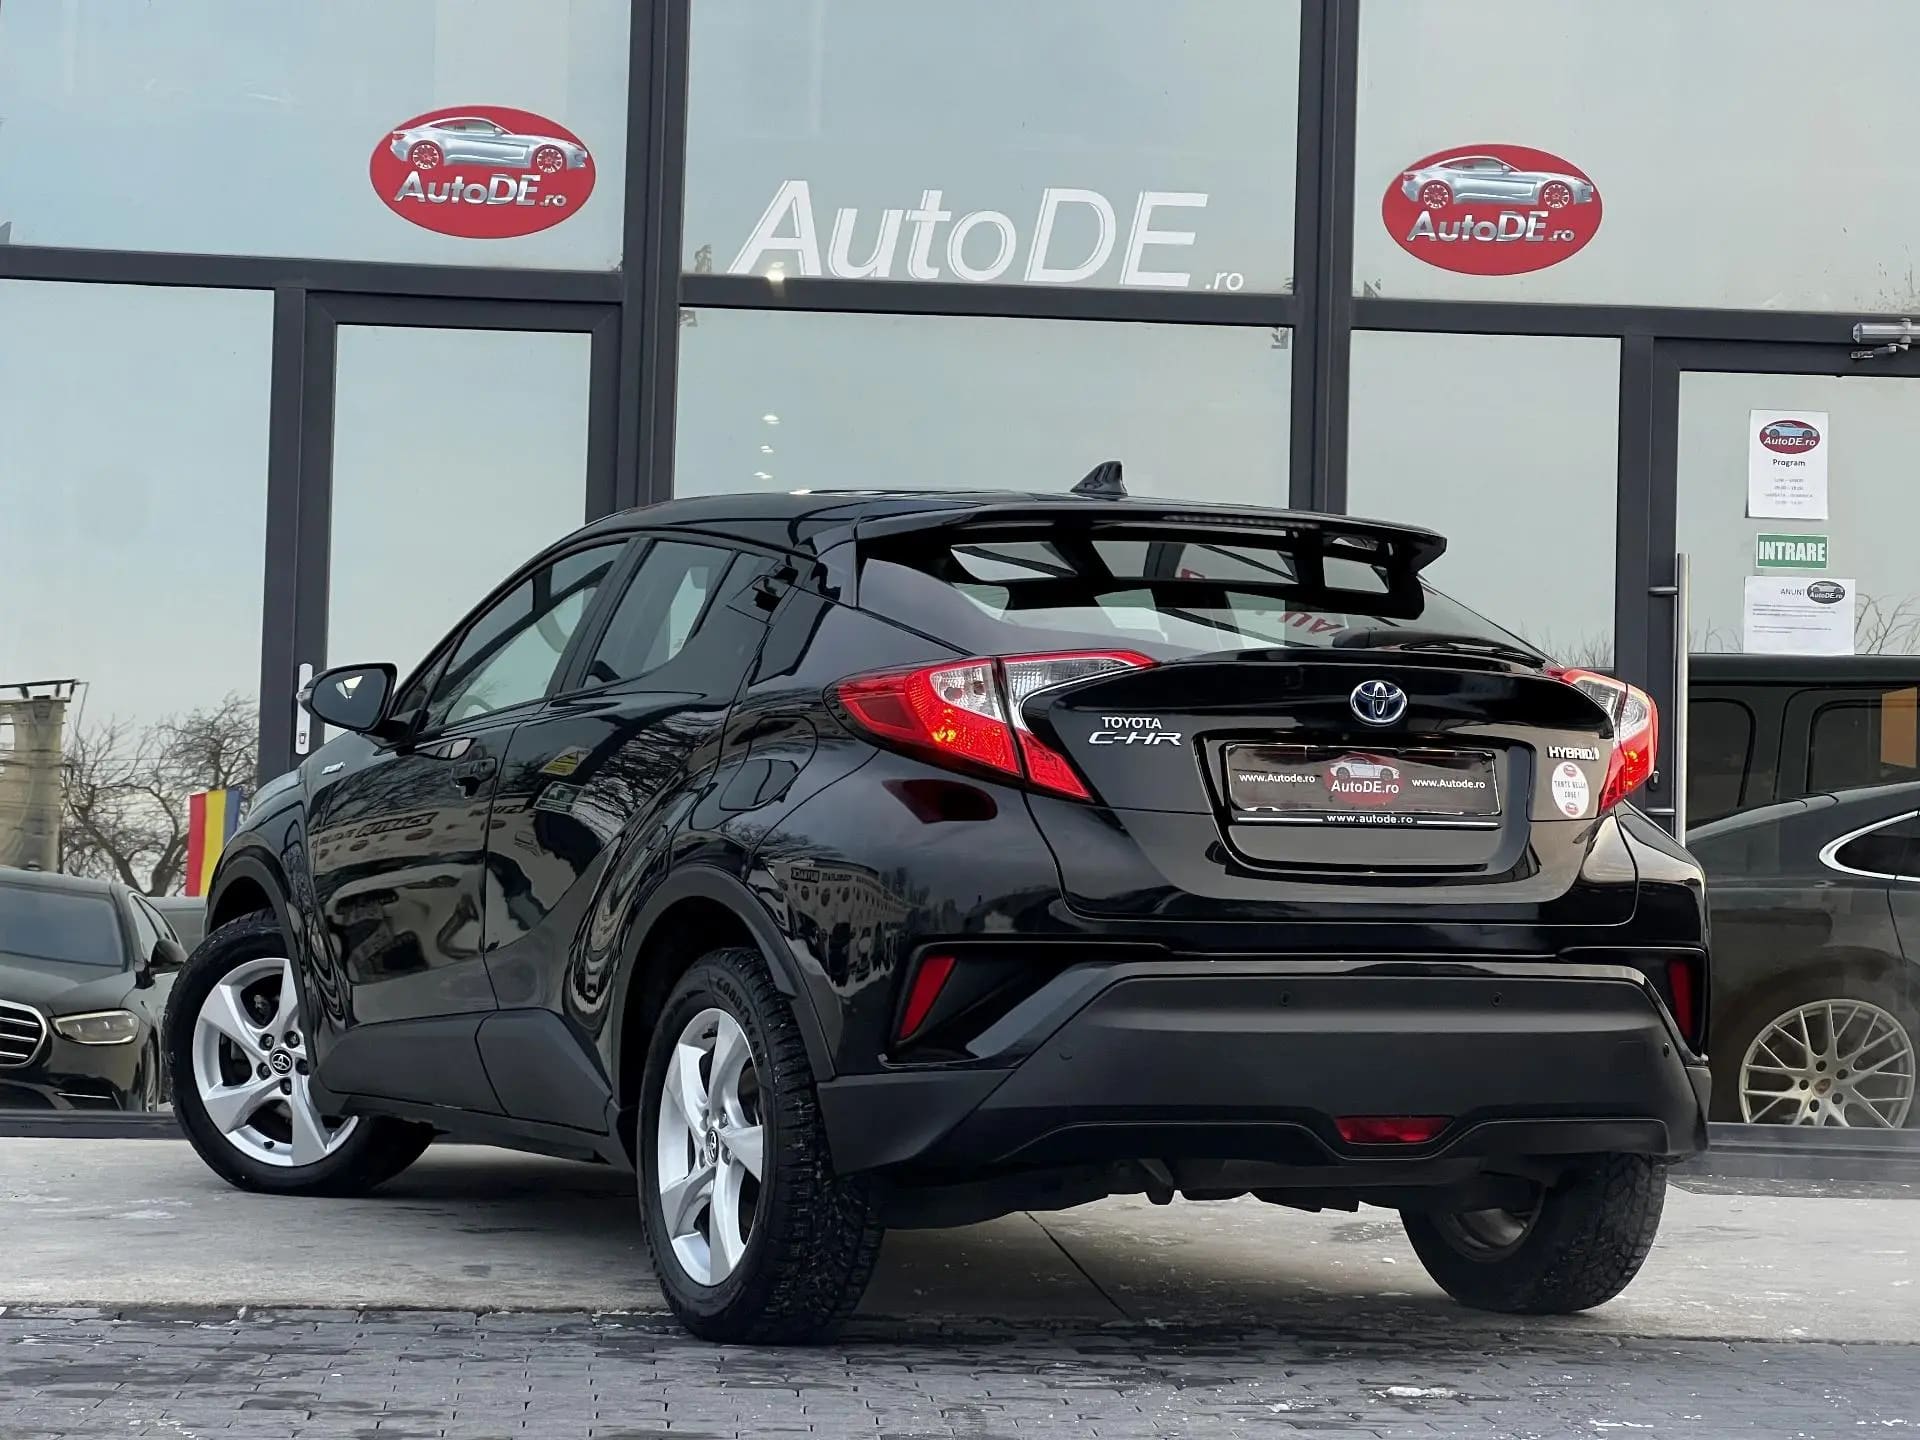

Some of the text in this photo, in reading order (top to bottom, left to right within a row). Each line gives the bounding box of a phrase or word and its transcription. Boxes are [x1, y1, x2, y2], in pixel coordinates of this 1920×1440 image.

[1763, 437, 1816, 447] AutoDE.ro
[1772, 458, 1806, 467] Program
[1759, 541, 1826, 561] INTRARE
[1101, 716, 1162, 729] TOYOTA
[1088, 731, 1182, 746] C-HR
[1548, 745, 1594, 760] HYBRID
[1239, 773, 1316, 783] www.Autode.ro
[1411, 778, 1486, 789] www.Autode.ro
[1330, 779, 1400, 794] AutoDE.ro
[1326, 814, 1413, 825] www.autode.ro
